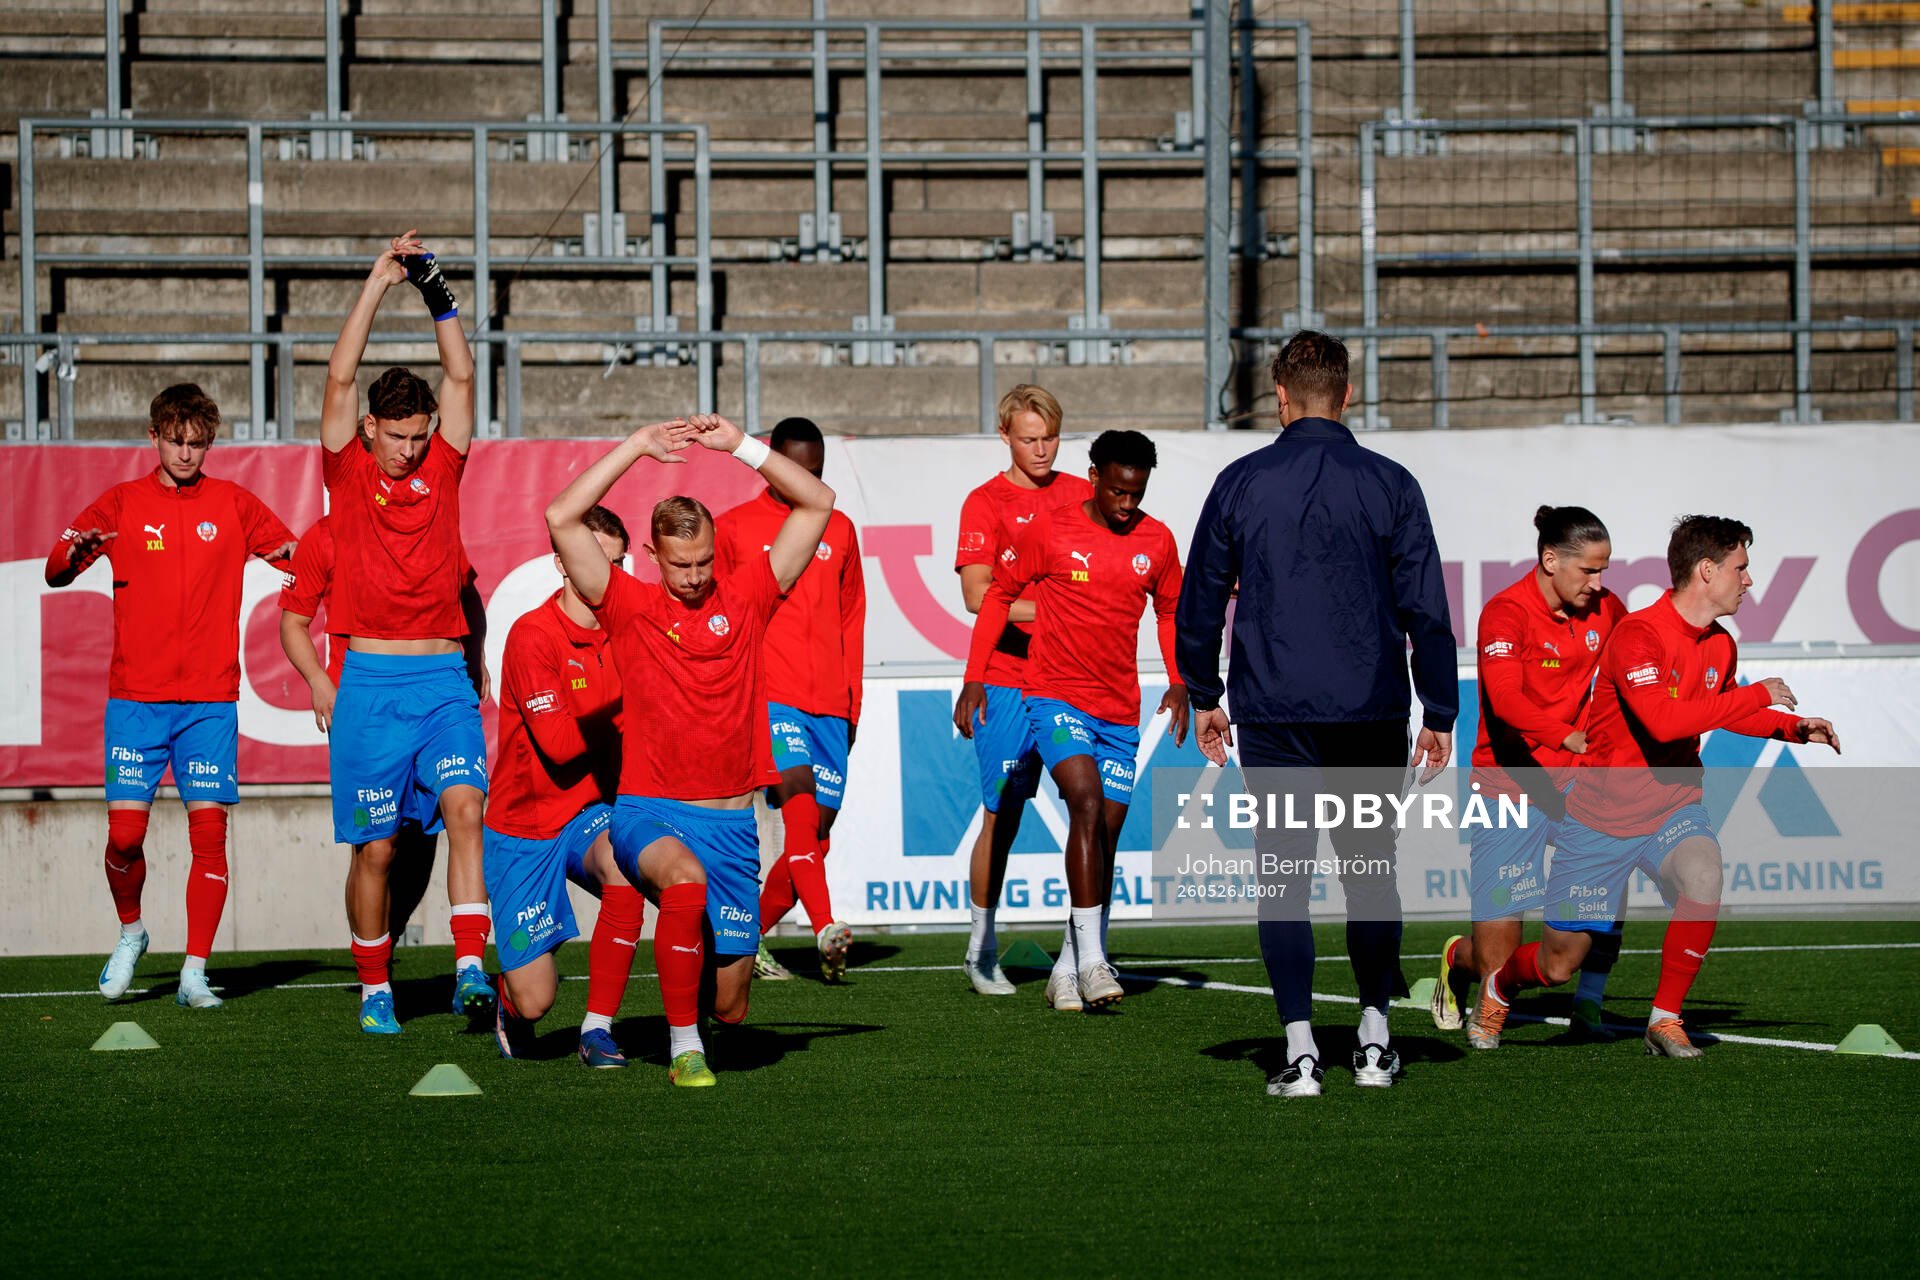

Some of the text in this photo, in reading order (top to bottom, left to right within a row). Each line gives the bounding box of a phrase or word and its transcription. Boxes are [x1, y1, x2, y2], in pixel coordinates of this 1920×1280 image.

[147, 541, 165, 551] XXL
[1071, 571, 1089, 582] XXL
[1485, 641, 1513, 653] UNIBET
[1541, 660, 1560, 668] XXL
[572, 678, 587, 690] XXL
[526, 694, 554, 709] UNIBET
[112, 747, 144, 763] Fibio
[118, 765, 143, 778] Solid
[188, 761, 219, 775] Fibio
[436, 754, 466, 775] Fibio
[1102, 759, 1134, 780] Fibio
[440, 769, 470, 781] Resurs
[812, 764, 842, 784] Fibio
[1104, 777, 1133, 793] Resur
[357, 787, 393, 802] Fibio
[369, 801, 397, 818] Solid
[1498, 861, 1533, 880] Fibio
[1042, 878, 1067, 907] &
[1510, 877, 1537, 894] Solid
[1569, 885, 1608, 899] Fibio
[1511, 888, 1546, 903] Försäkring
[517, 901, 547, 926] Fibio
[1578, 901, 1608, 912] Solid
[720, 906, 753, 923] Fibio
[1578, 913, 1616, 922] Försäkring
[528, 914, 554, 936] Solid
[723, 928, 750, 939] Resurs
